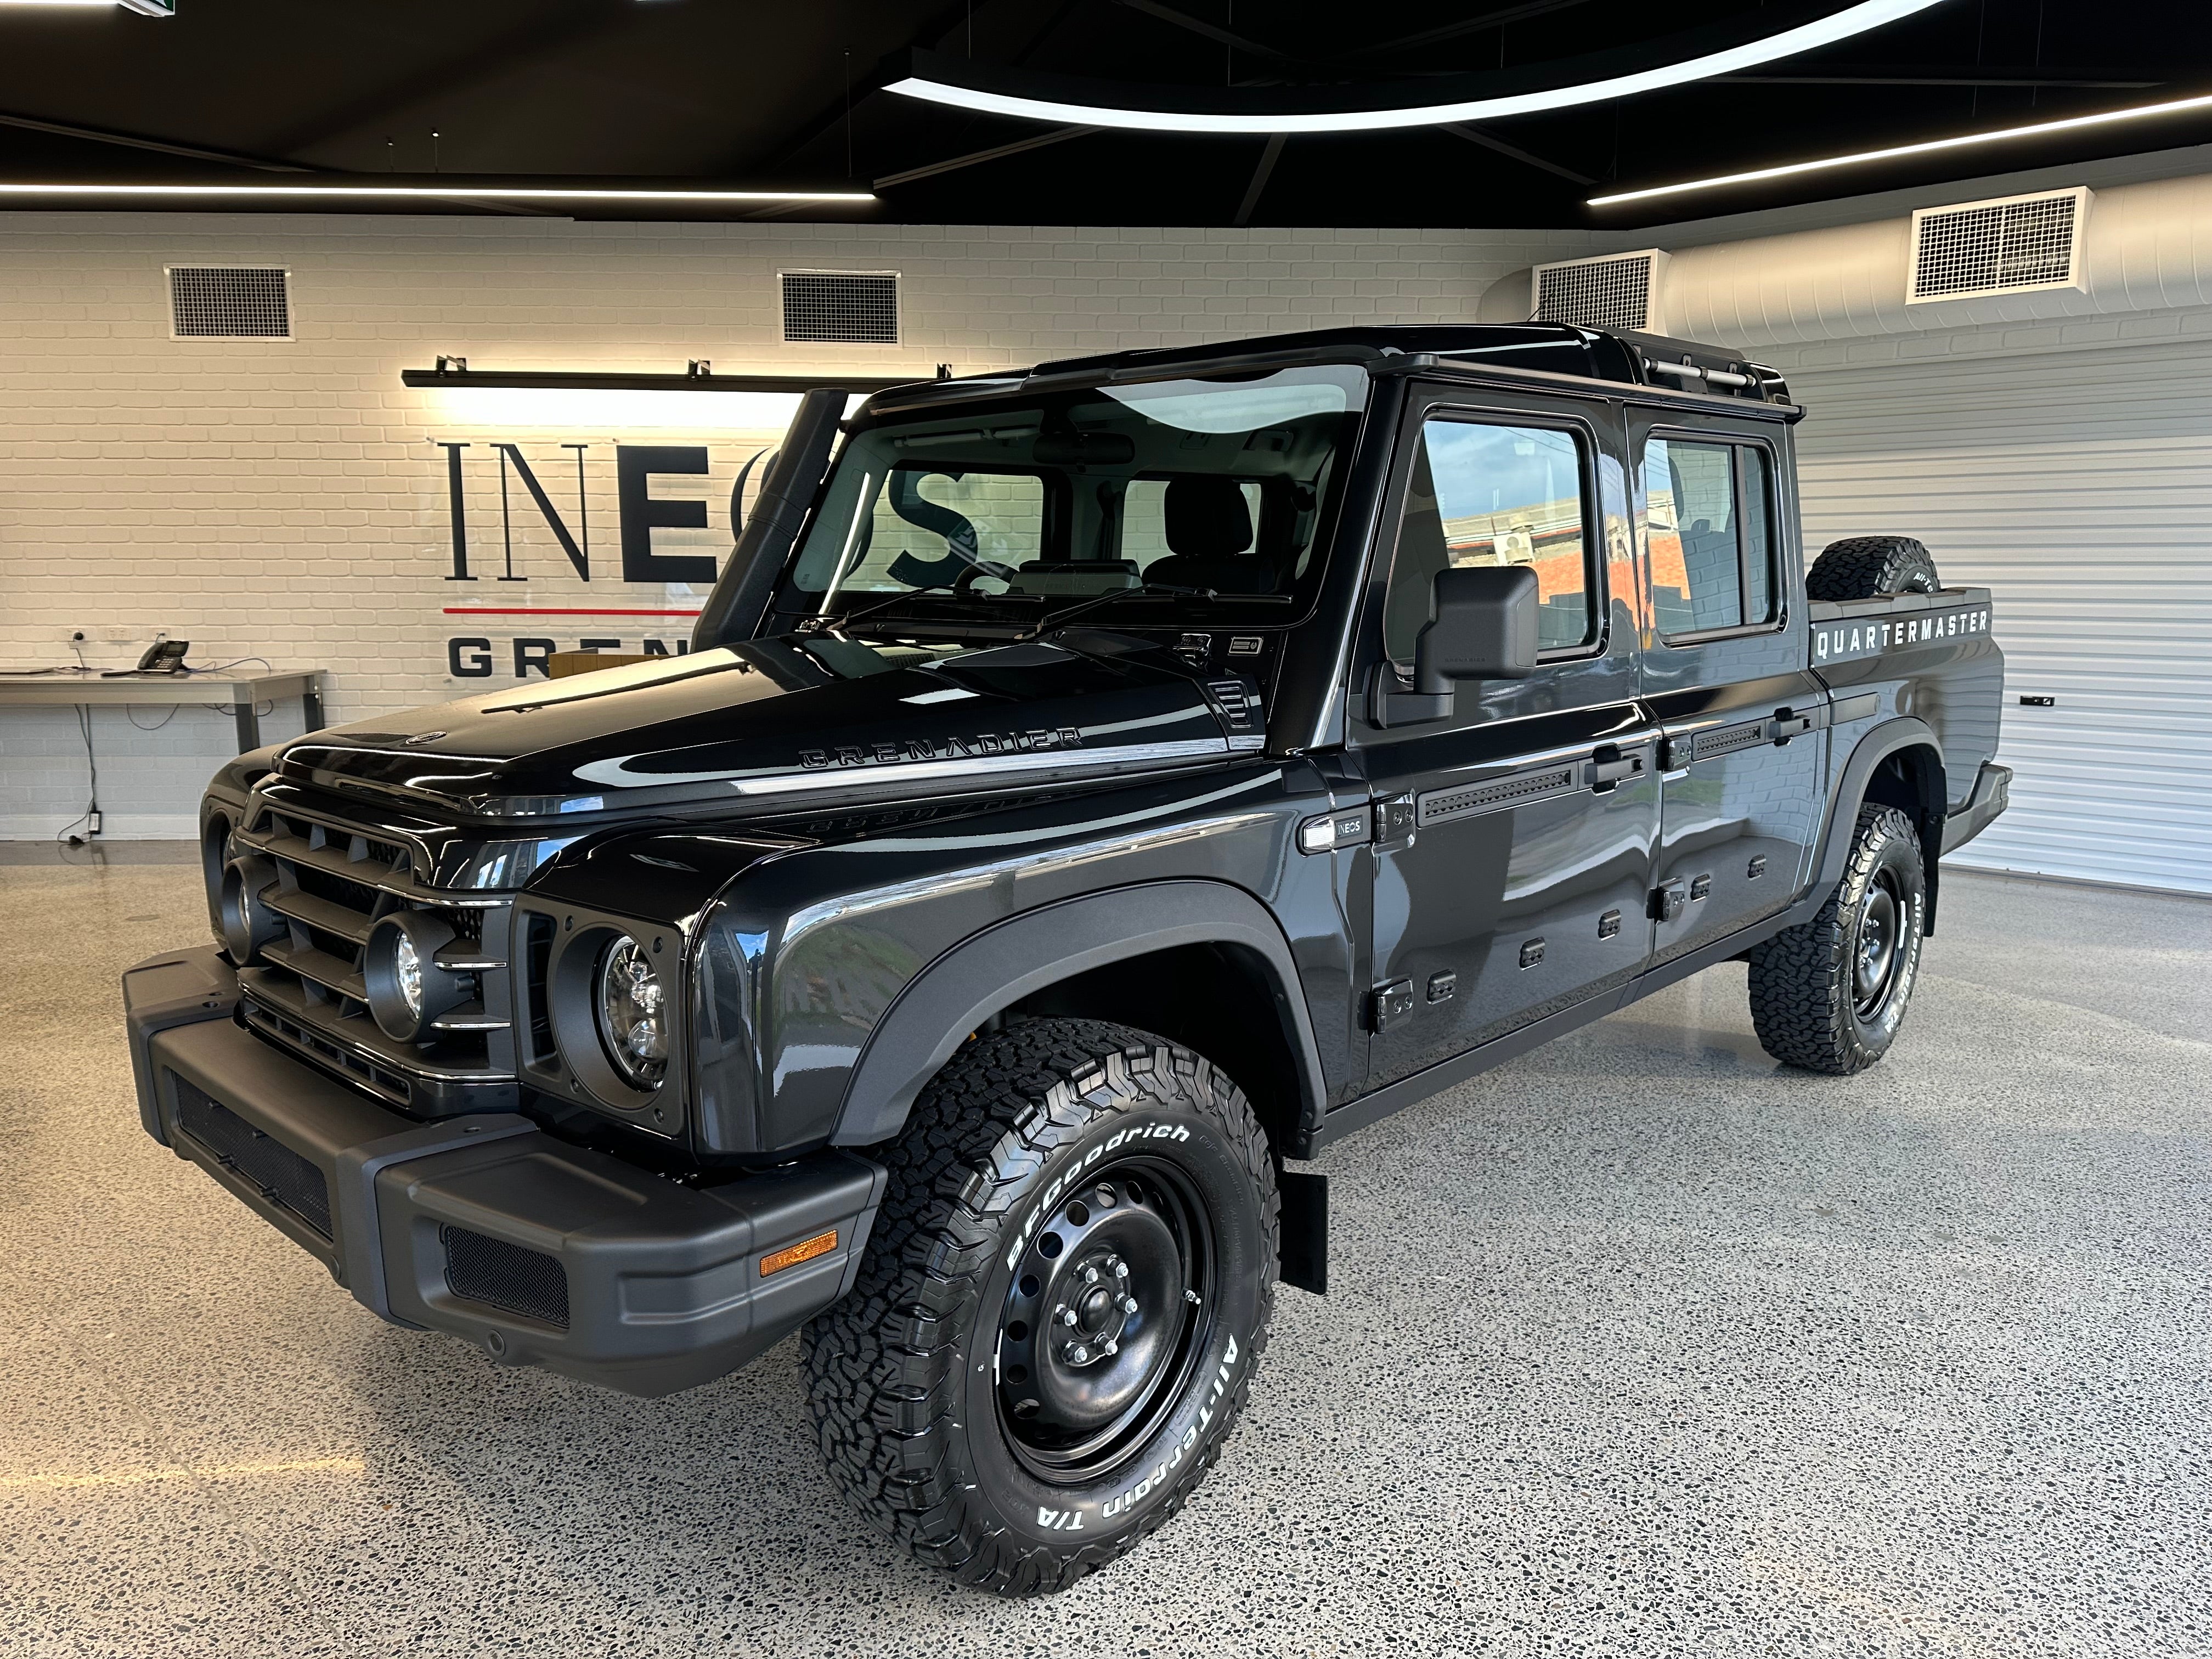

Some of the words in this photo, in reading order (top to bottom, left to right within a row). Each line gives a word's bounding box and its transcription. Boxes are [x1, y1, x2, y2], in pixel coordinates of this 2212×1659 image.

[1818, 611, 1987, 659] QUARTERMASTER
[798, 726, 1084, 769] GRENADIER
[1338, 820, 1361, 835] INEOS
[1006, 1122, 1190, 1272] BFGoodrich
[1102, 1333, 1239, 1519] All-Terrain
[1037, 1506, 1084, 1531] T/A
